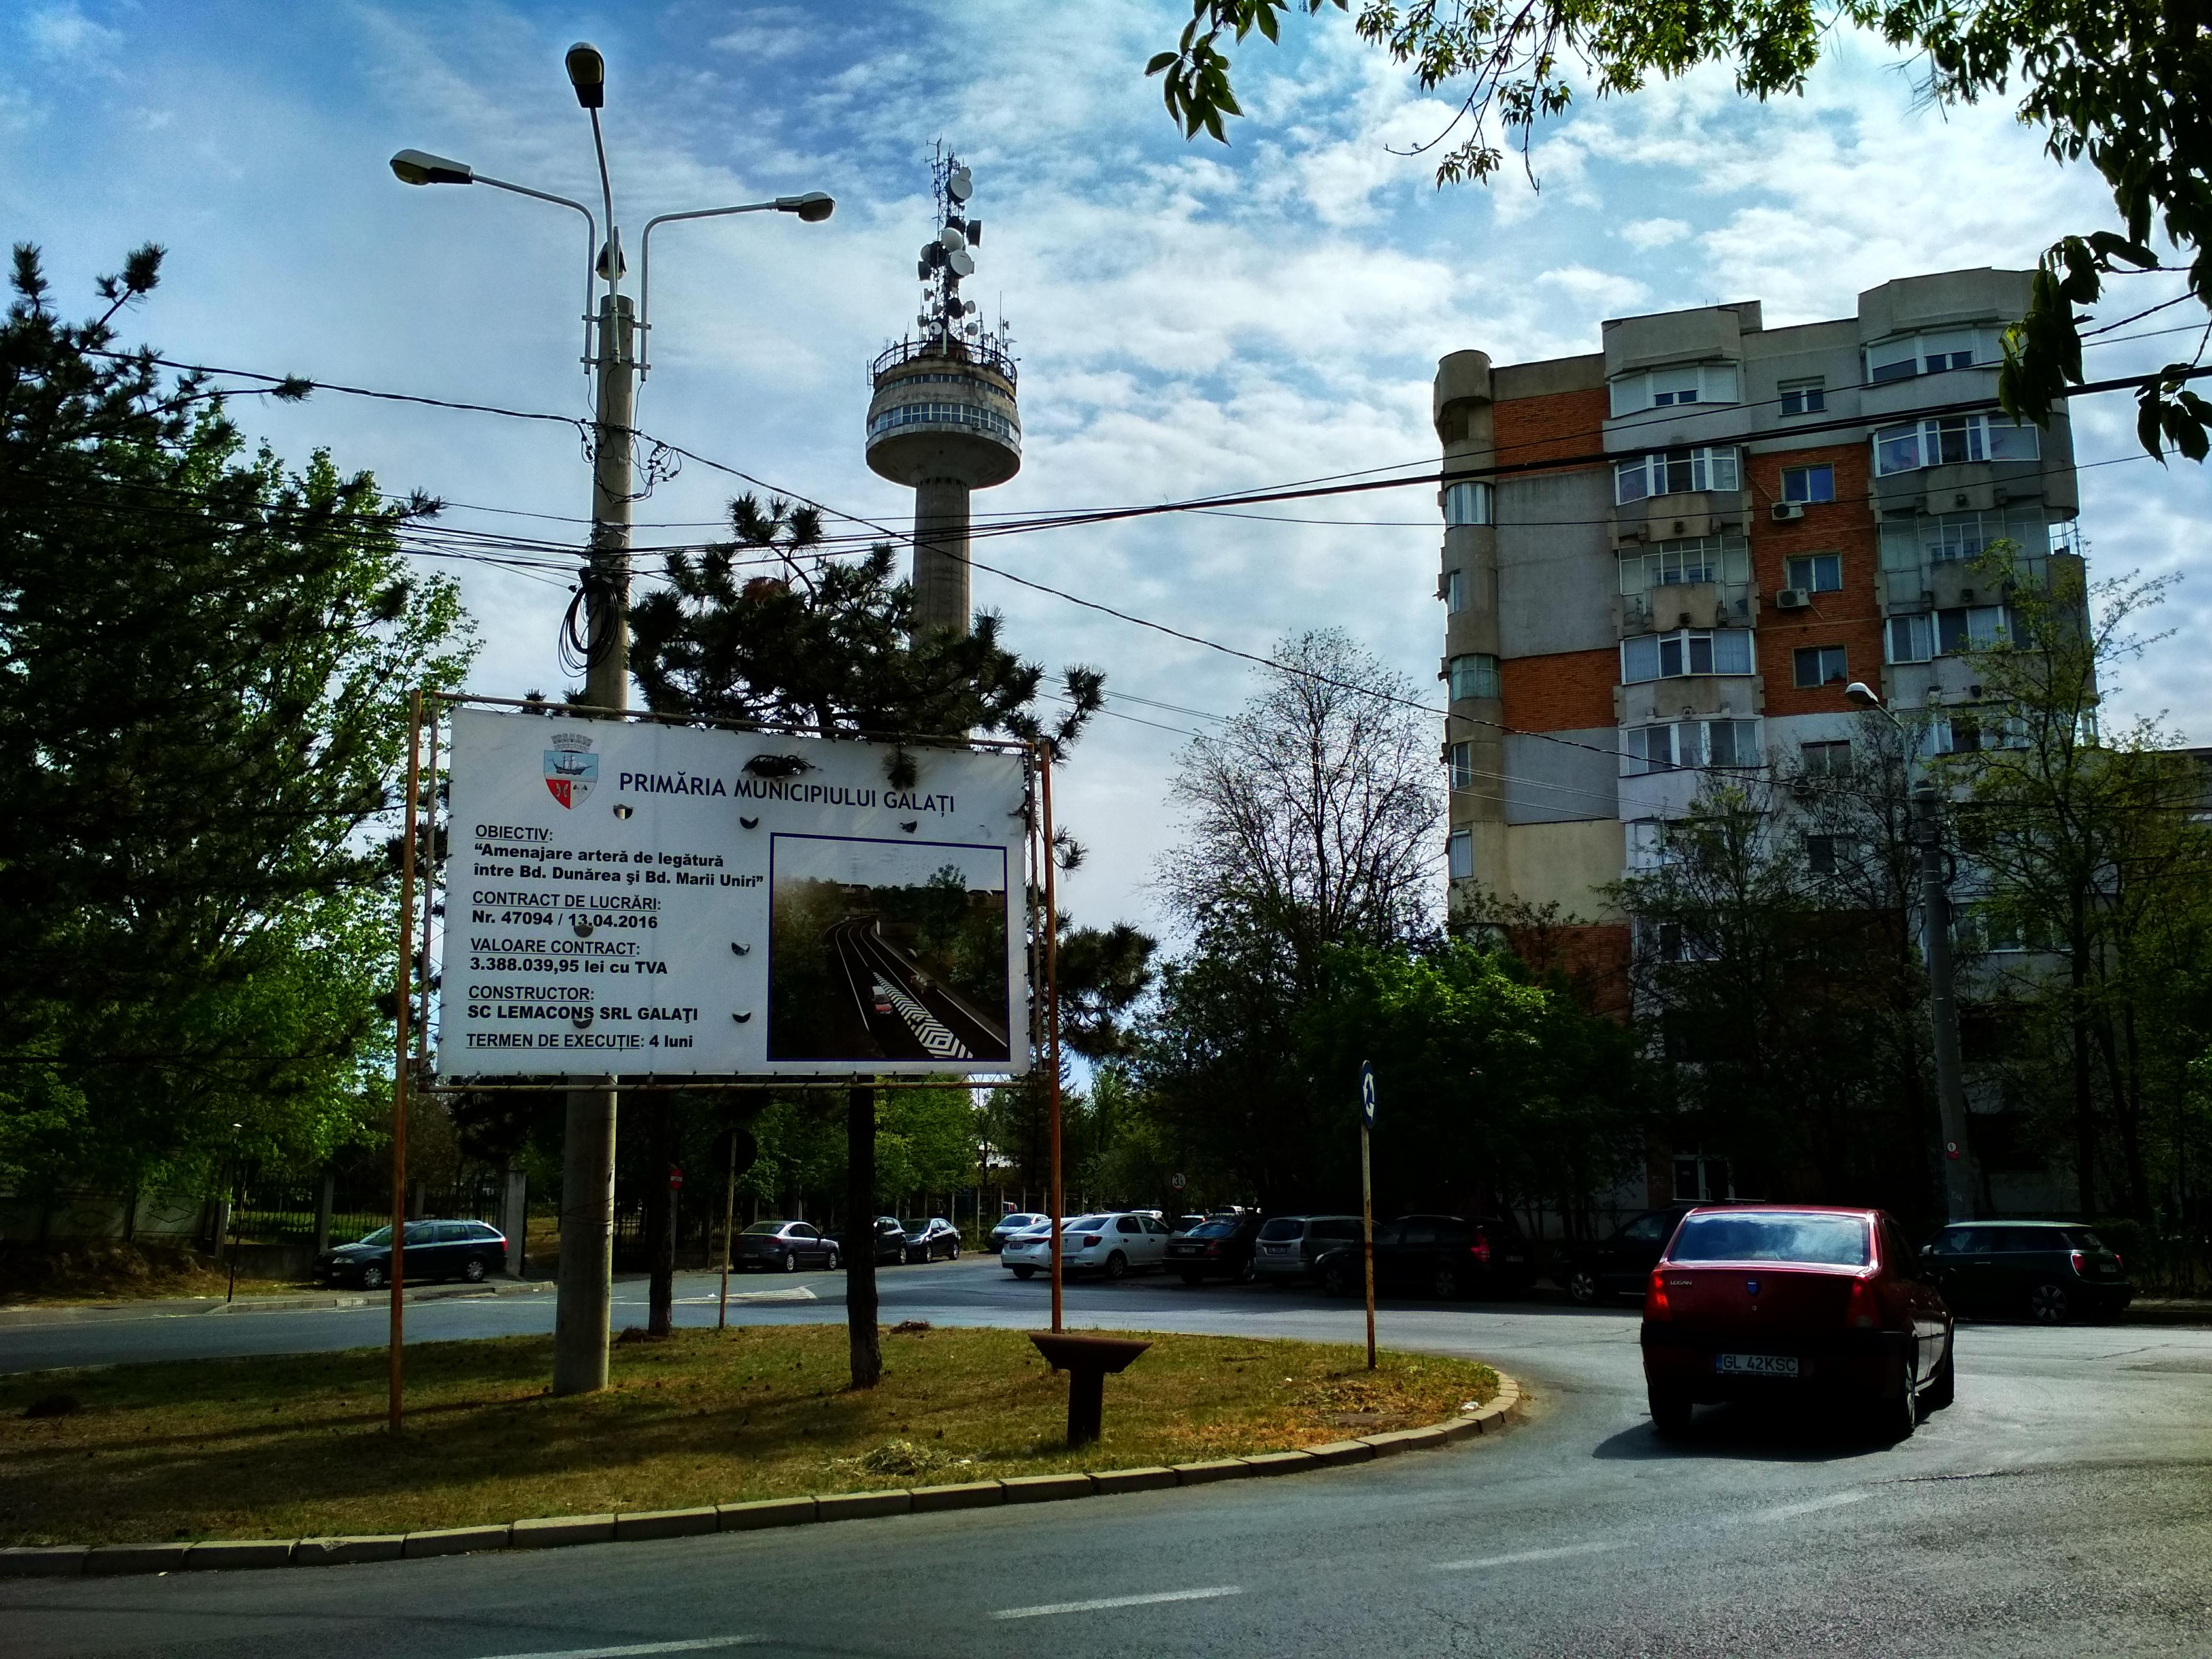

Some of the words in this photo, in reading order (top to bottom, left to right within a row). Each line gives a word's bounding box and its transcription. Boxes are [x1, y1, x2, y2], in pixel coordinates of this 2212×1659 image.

[620, 771, 727, 797] PRIMĂRIA
[734, 778, 876, 808] MUNICIPIULUI
[475, 824, 553, 841] OBIECTIV:
[577, 849, 629, 863] arteră
[633, 851, 653, 864] de
[658, 852, 724, 868] legătură
[474, 862, 515, 877] între
[520, 865, 547, 879] Bd.
[552, 867, 621, 882] Dunărea
[645, 870, 671, 884] Bd.
[676, 872, 715, 886] Marii
[472, 890, 560, 907] CONTRACT
[564, 894, 585, 908] DE
[590, 894, 661, 911] LUCRĂRI:
[472, 910, 496, 924] Nr.
[501, 911, 554, 925] 47094
[558, 913, 563, 926] /
[568, 913, 658, 929] 13.04.2016
[470, 937, 546, 953] VALOARE
[550, 940, 640, 956] CONTRACT:
[470, 957, 579, 975] 3.388.039,95
[584, 960, 604, 973] lei
[609, 962, 630, 974] cu
[634, 961, 668, 974] TVA
[468, 985, 594, 1000] CONSTRUCTOR:
[467, 1005, 491, 1018] SC
[497, 1005, 594, 1019] LEMACONS
[599, 1007, 632, 1020] SRL
[466, 1033, 533, 1047] TERMEN
[538, 1034, 559, 1047] DE
[649, 1034, 659, 1048] 4
[664, 1034, 693, 1048] luni
[1723, 1355, 1741, 1369] GL
[1747, 1356, 1796, 1372] 42KSC
